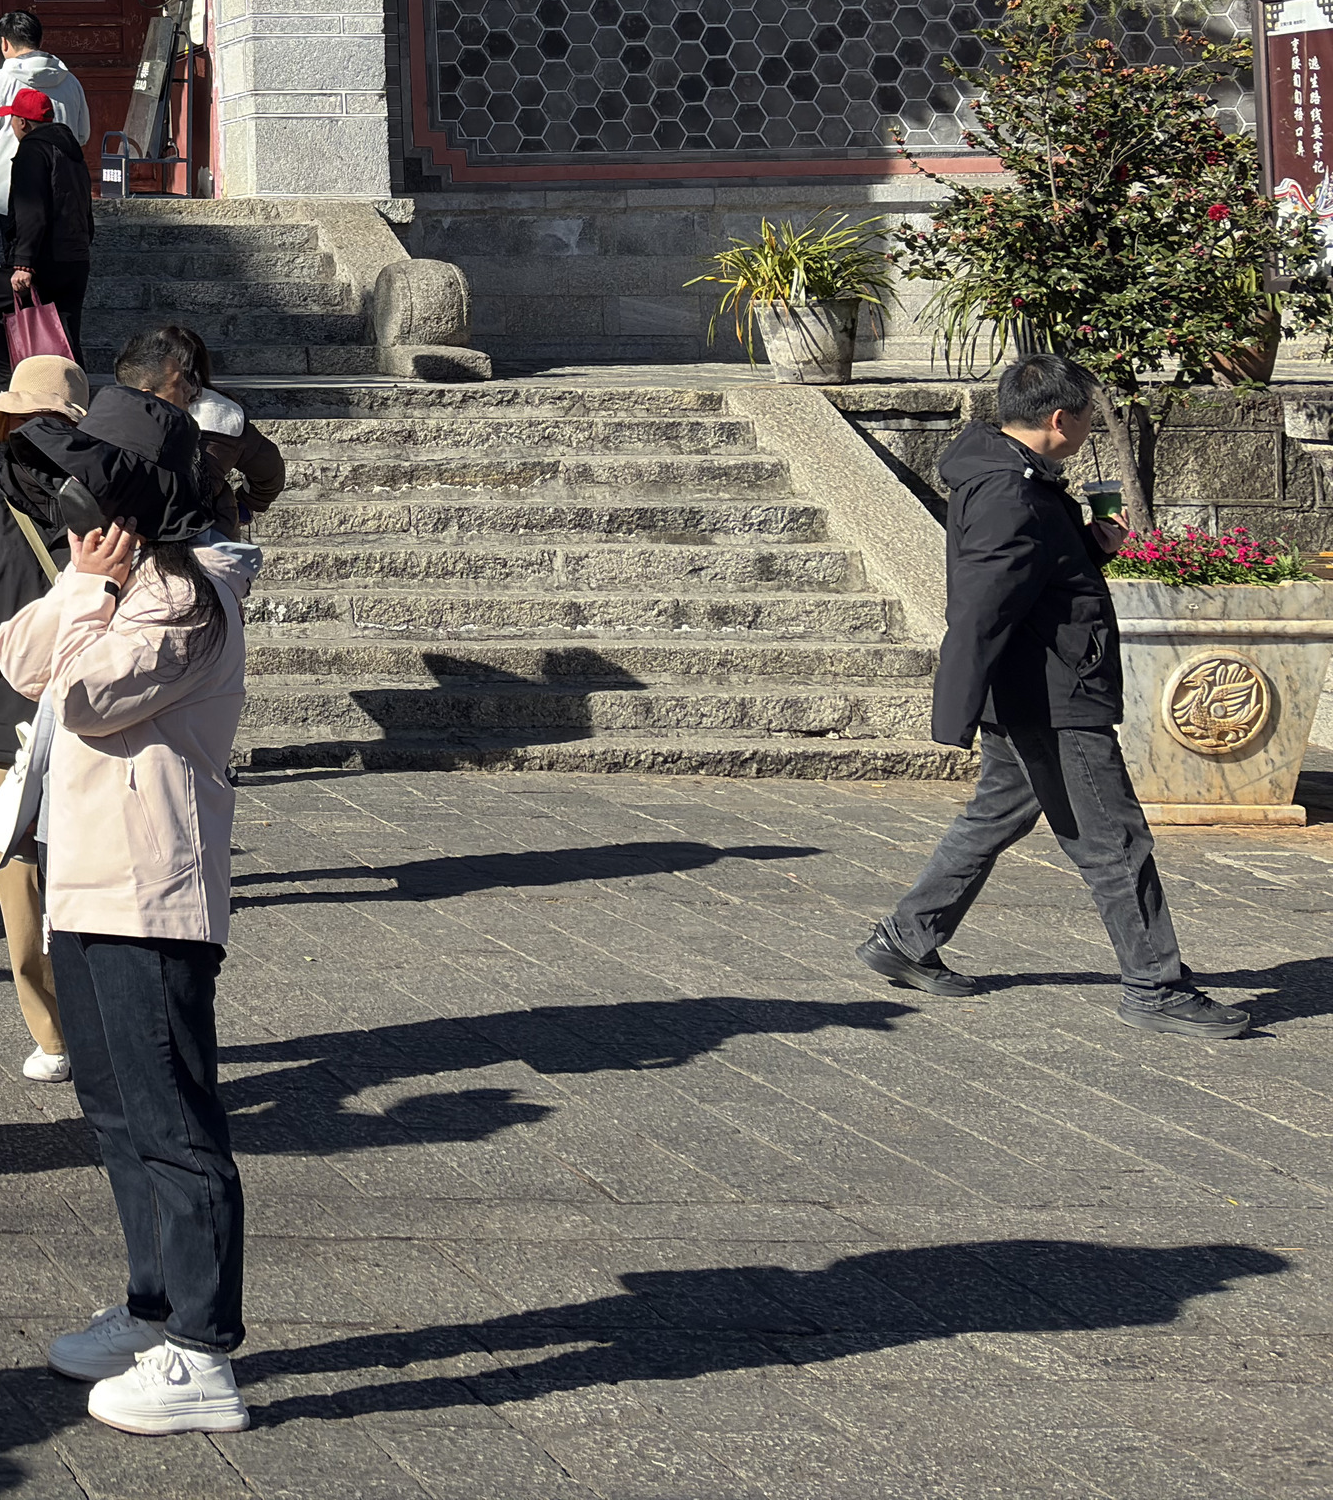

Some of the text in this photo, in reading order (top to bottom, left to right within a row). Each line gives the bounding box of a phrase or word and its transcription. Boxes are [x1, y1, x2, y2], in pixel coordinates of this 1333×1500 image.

[1308, 56, 1325, 174] 逃生路线要牢记
